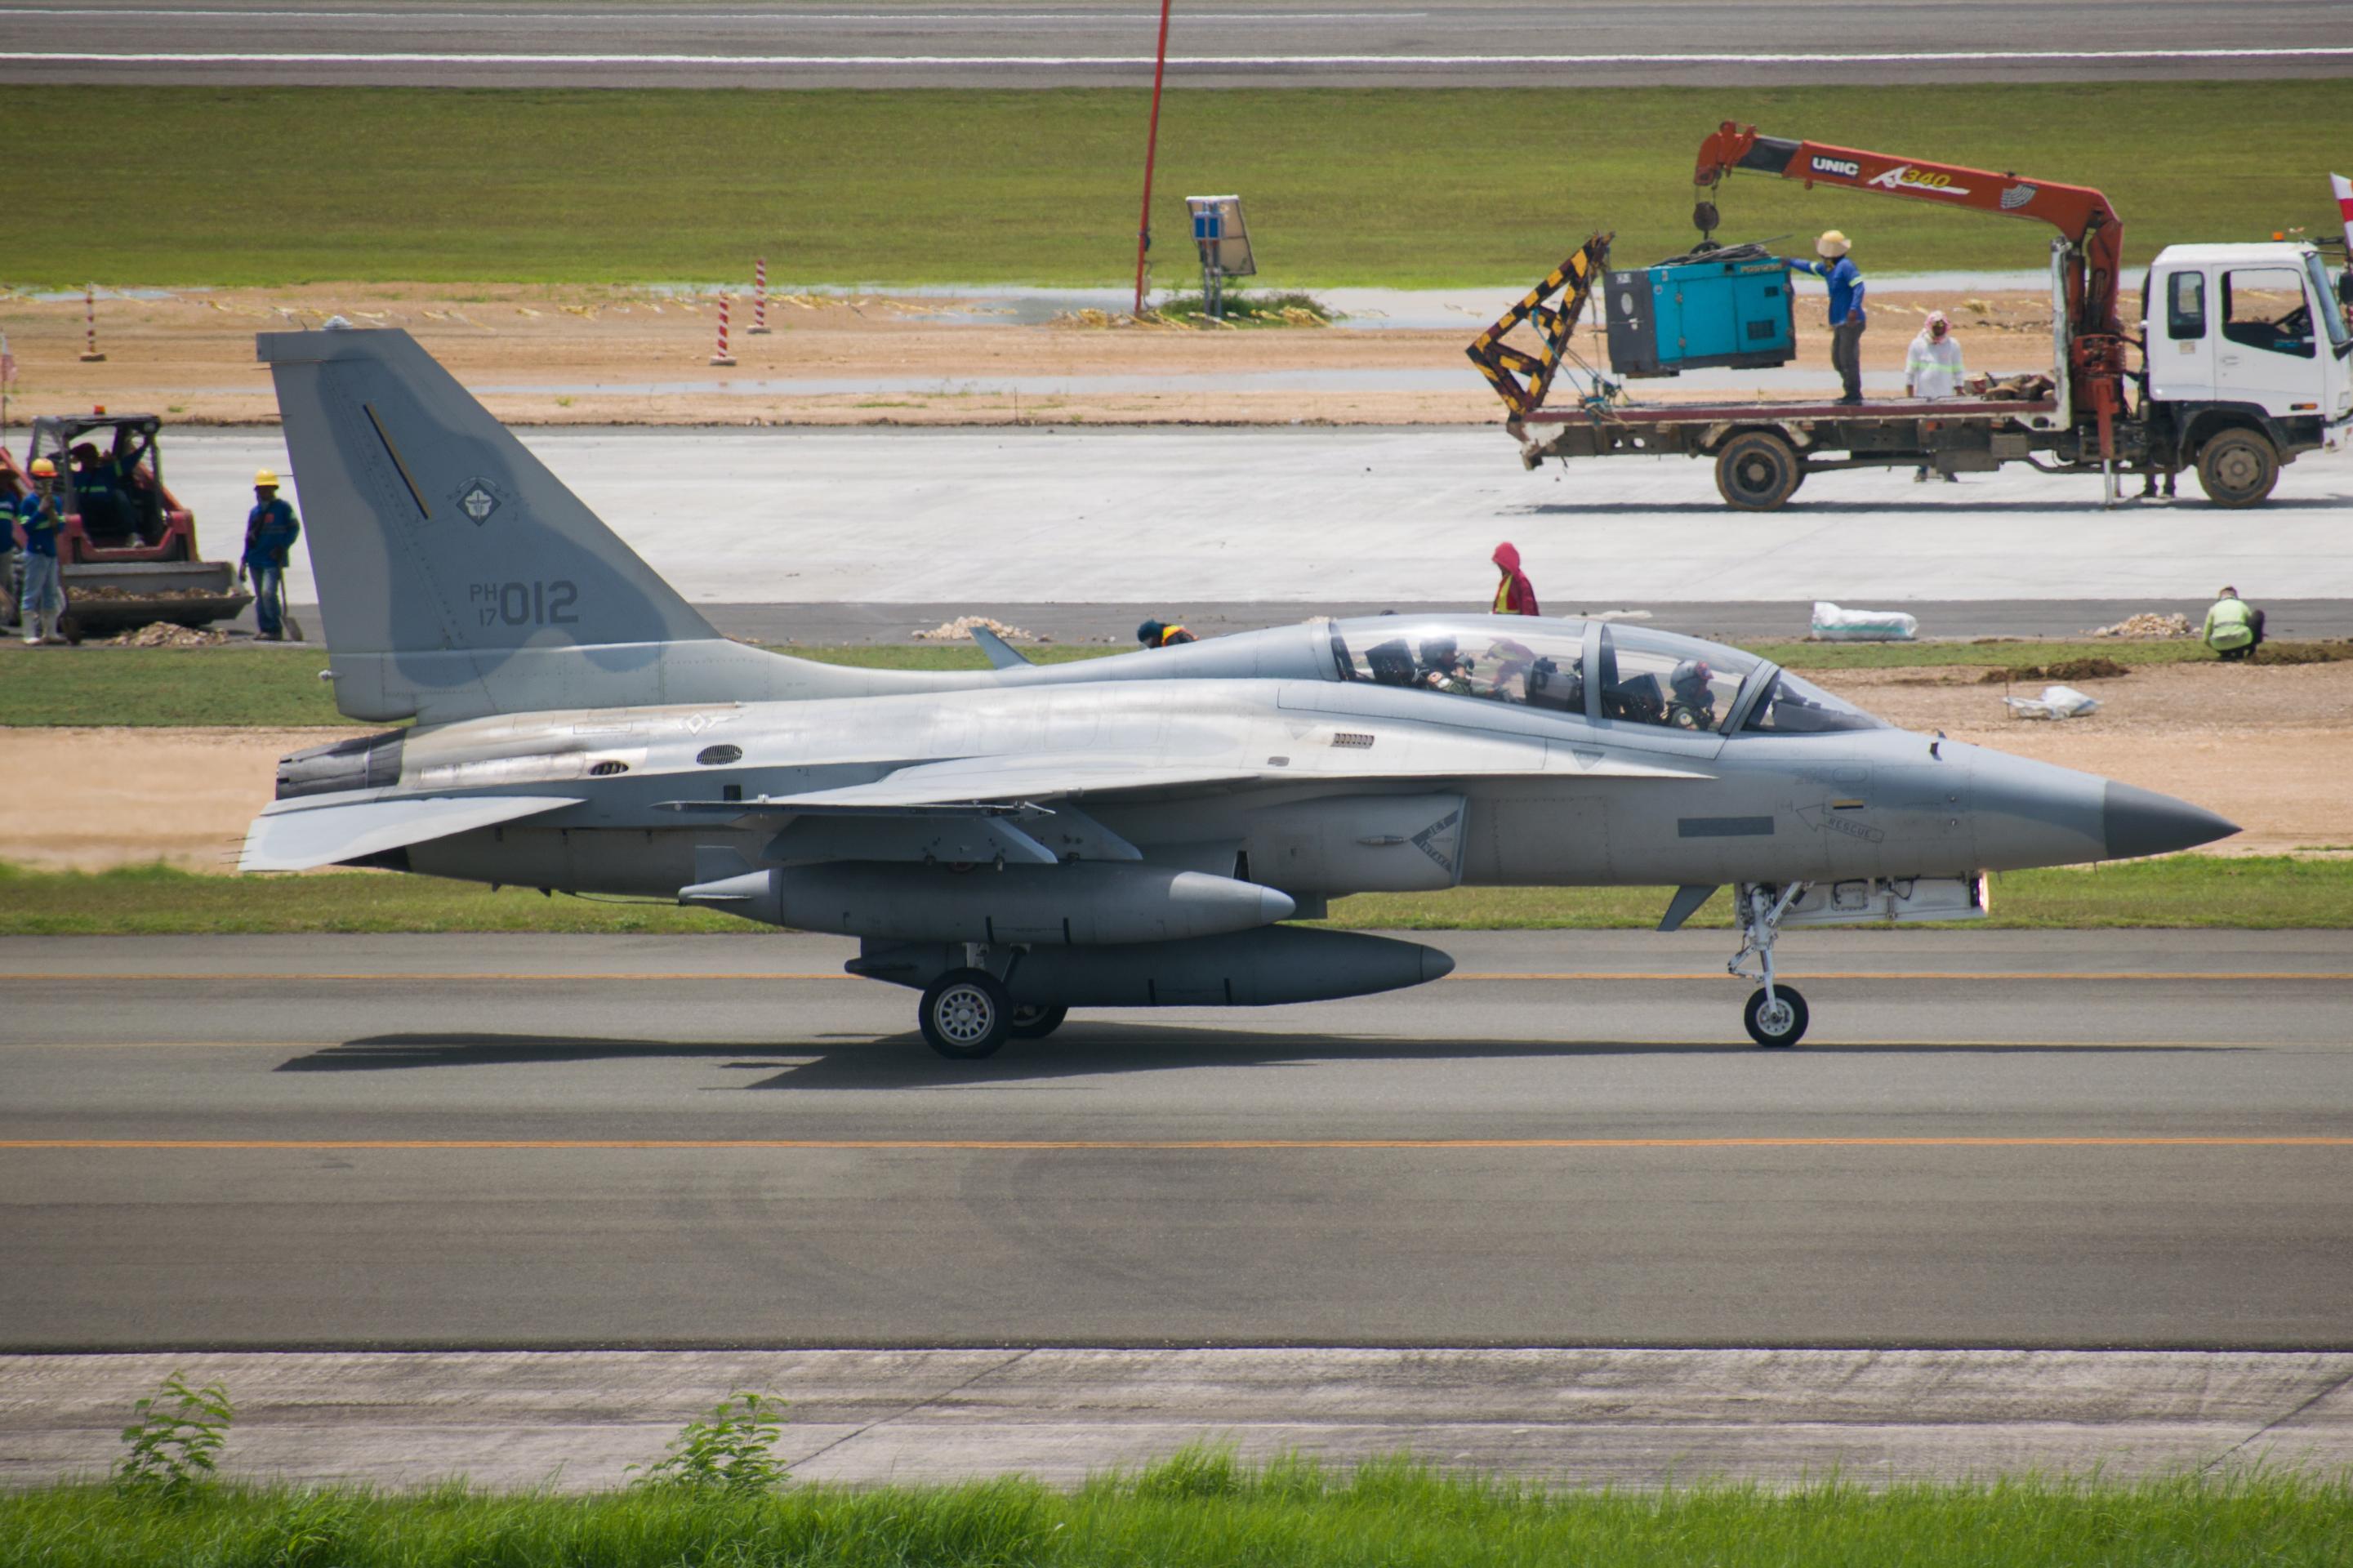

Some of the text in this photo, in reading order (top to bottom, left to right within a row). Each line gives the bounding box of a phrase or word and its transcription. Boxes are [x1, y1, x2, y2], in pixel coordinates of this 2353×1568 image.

[1812, 157, 1859, 176] UNIC
[470, 583, 497, 603] PH
[500, 580, 579, 626] 012
[479, 608, 497, 626] 17
[1428, 818, 1446, 837] JET
[1829, 817, 1870, 838] RESCUE
